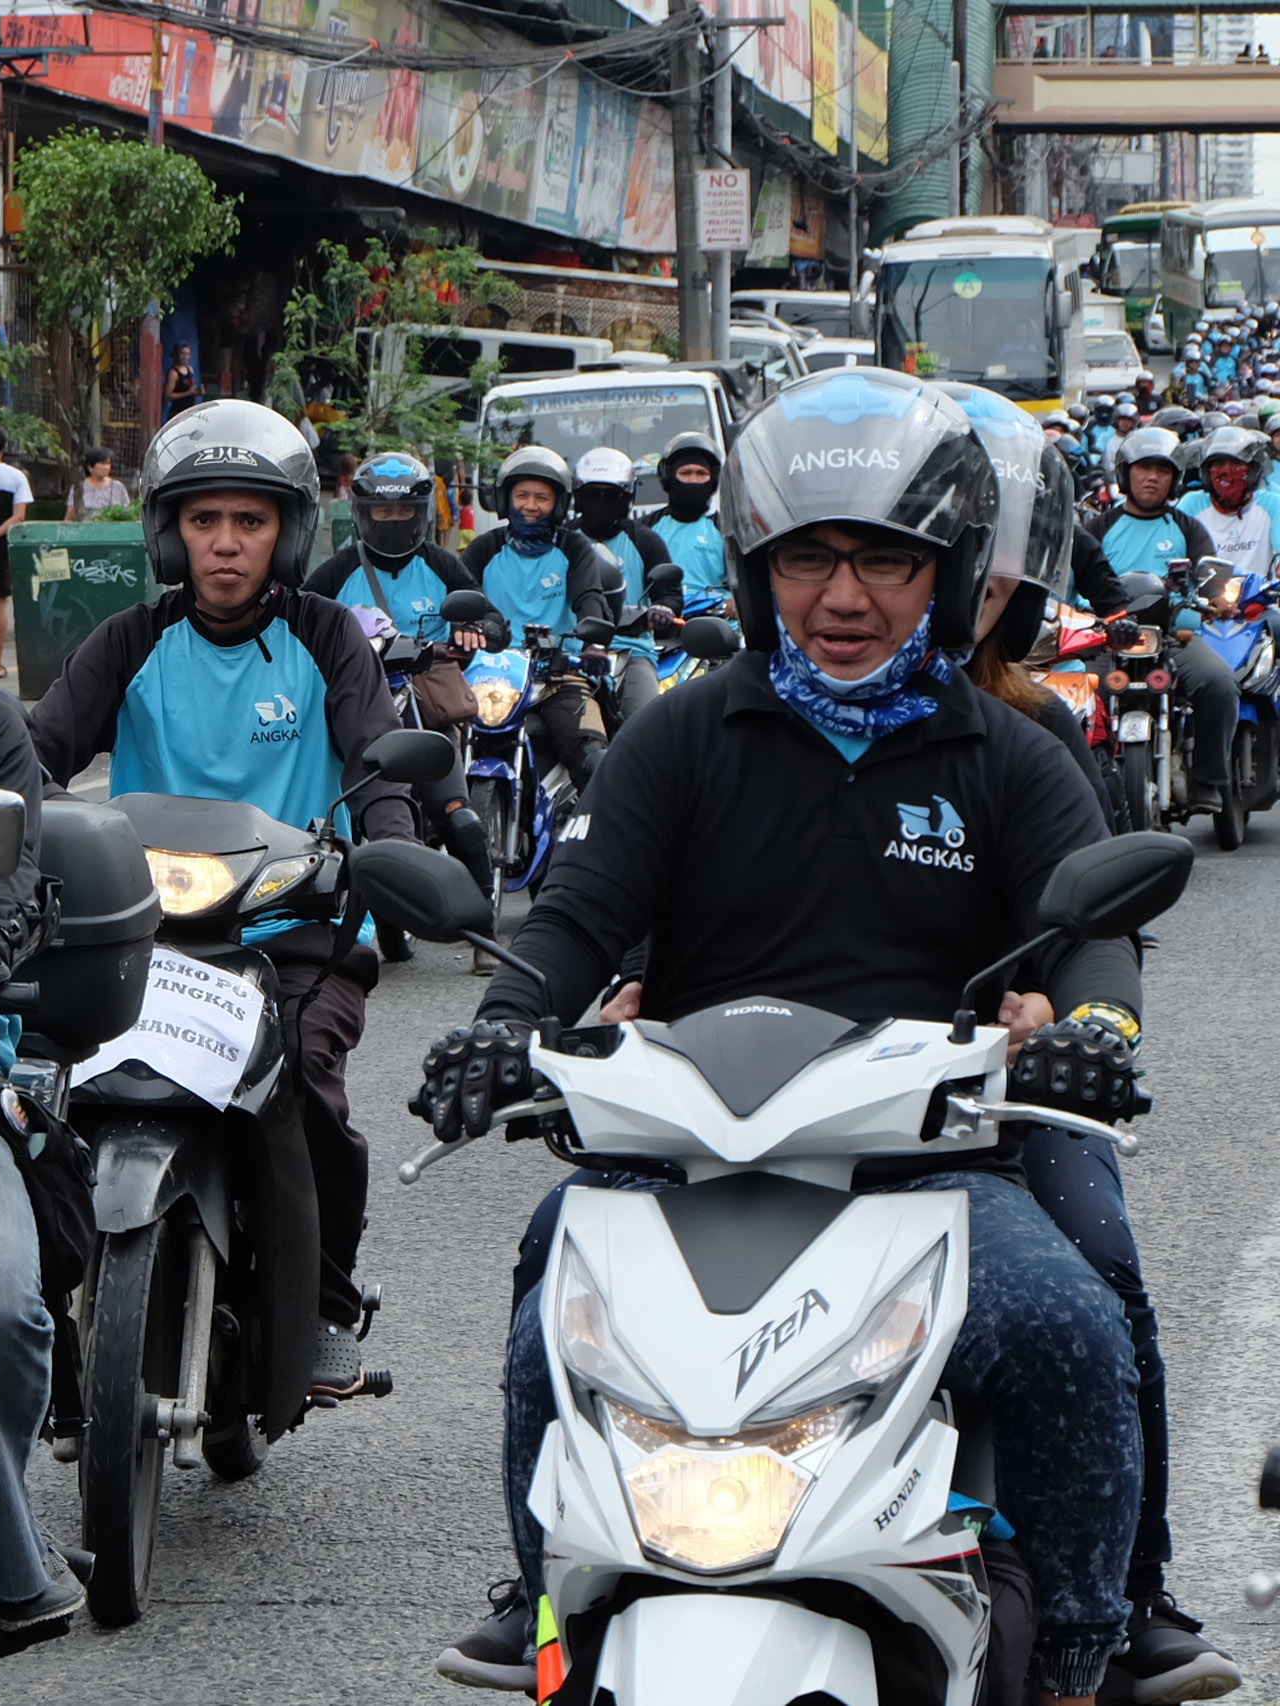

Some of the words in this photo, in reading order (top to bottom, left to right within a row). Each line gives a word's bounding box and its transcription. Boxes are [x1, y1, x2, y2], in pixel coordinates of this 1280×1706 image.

[710, 174, 738, 188] NO
[788, 448, 901, 475] ANGKAS
[990, 458, 1046, 491] GKAS
[375, 484, 411, 494] ANGKAS
[250, 728, 302, 744] ANGKA
[884, 840, 975, 873] ANGKAS
[150, 959, 211, 982] ASKO
[153, 978, 246, 1022] ANGKAS
[724, 1005, 793, 1017] HONDA
[131, 1019, 240, 1062] HANGKAS
[873, 1467, 922, 1533] HONDA
